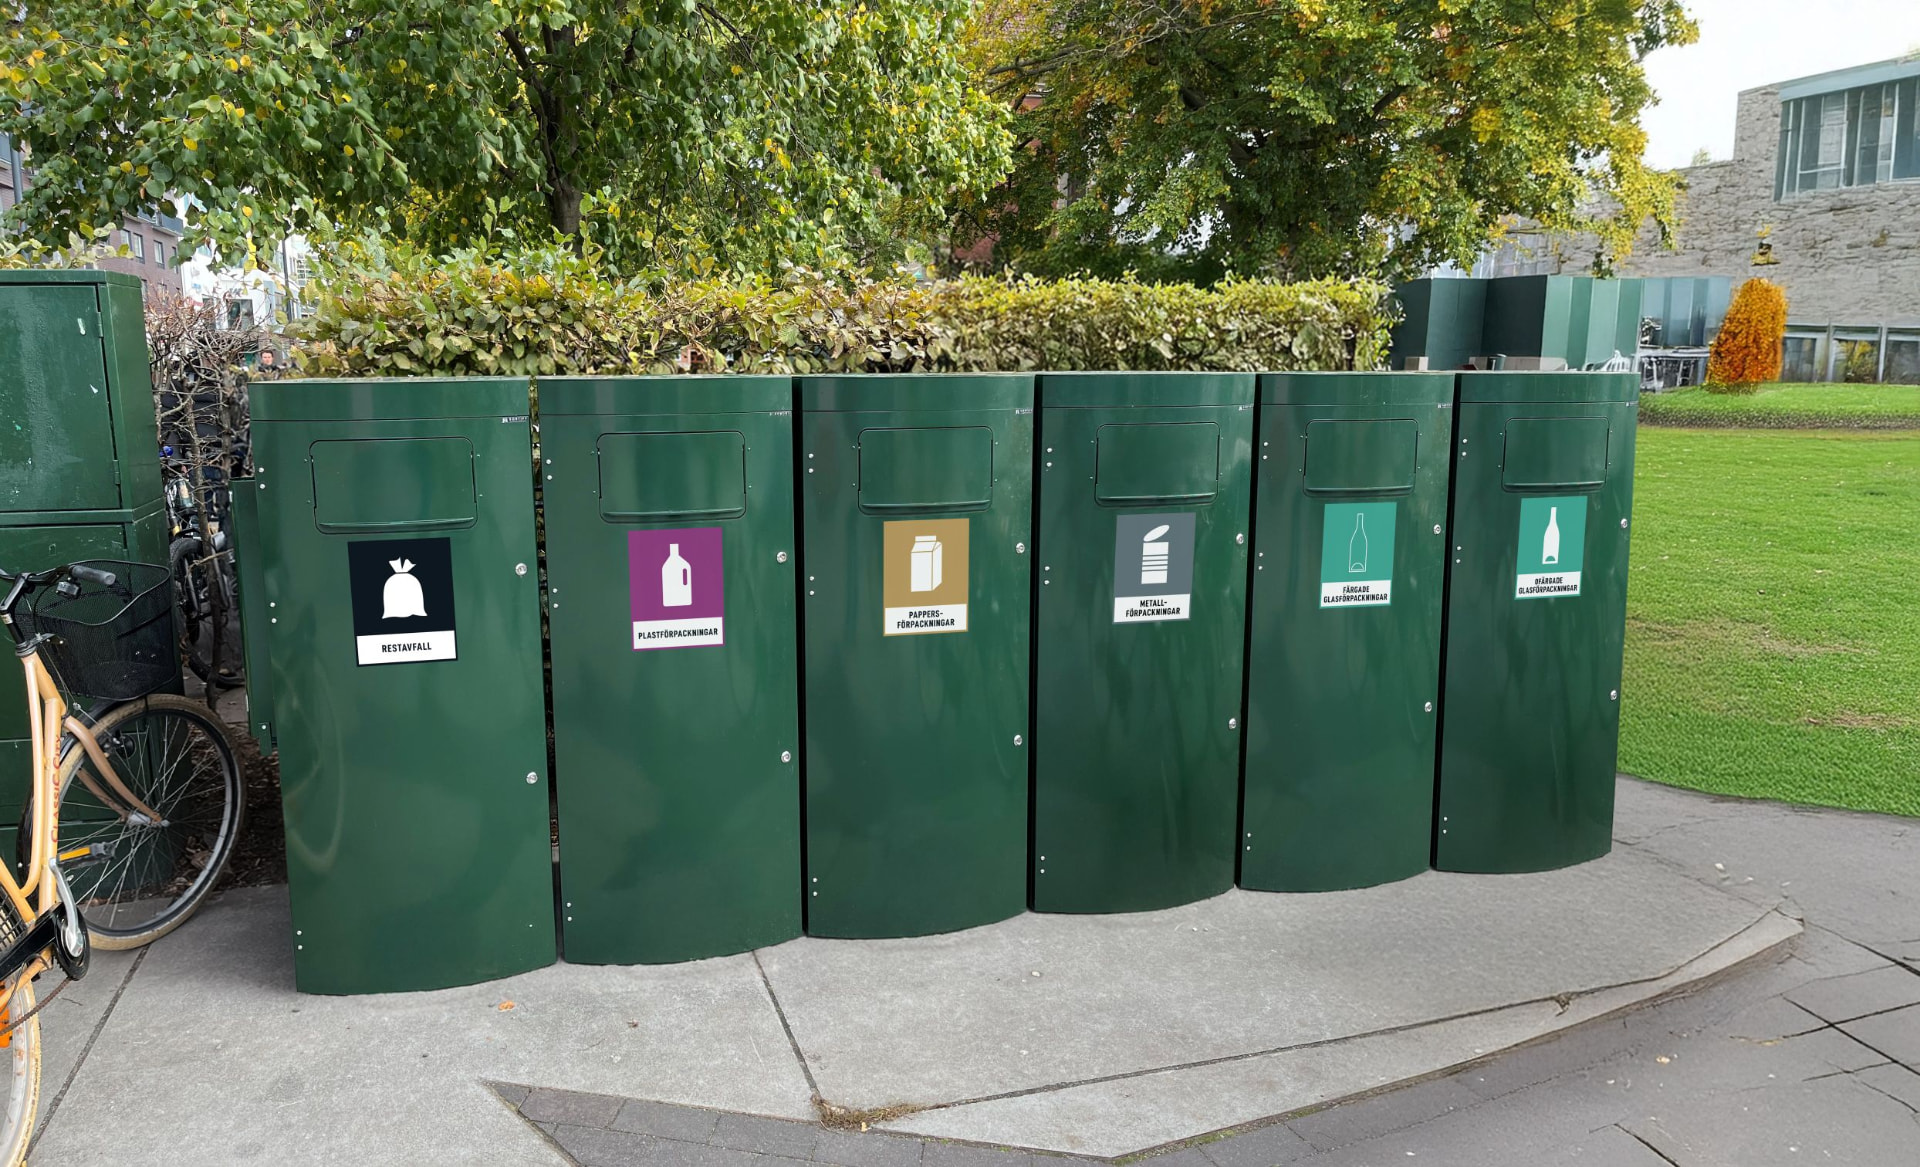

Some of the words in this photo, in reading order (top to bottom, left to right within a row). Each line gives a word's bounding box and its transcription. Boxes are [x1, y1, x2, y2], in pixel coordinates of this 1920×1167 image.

[1534, 576, 1564, 585] OFÄRGADE
[1342, 584, 1370, 594] FÄRGADE
[1518, 584, 1578, 595] GLASFÖRPACKNINGAR
[1139, 598, 1168, 608] METALL-
[1323, 593, 1388, 603] GLASFÖRPACKNINGAR
[908, 610, 944, 619] PAPPERS-
[1125, 607, 1181, 617] FÖRPACKNINGAR
[896, 618, 955, 629] FÖRPACKNINGAR
[638, 627, 718, 640] PLASTFÖRPACKNINGAR
[381, 642, 432, 653] RESTAVFALL
